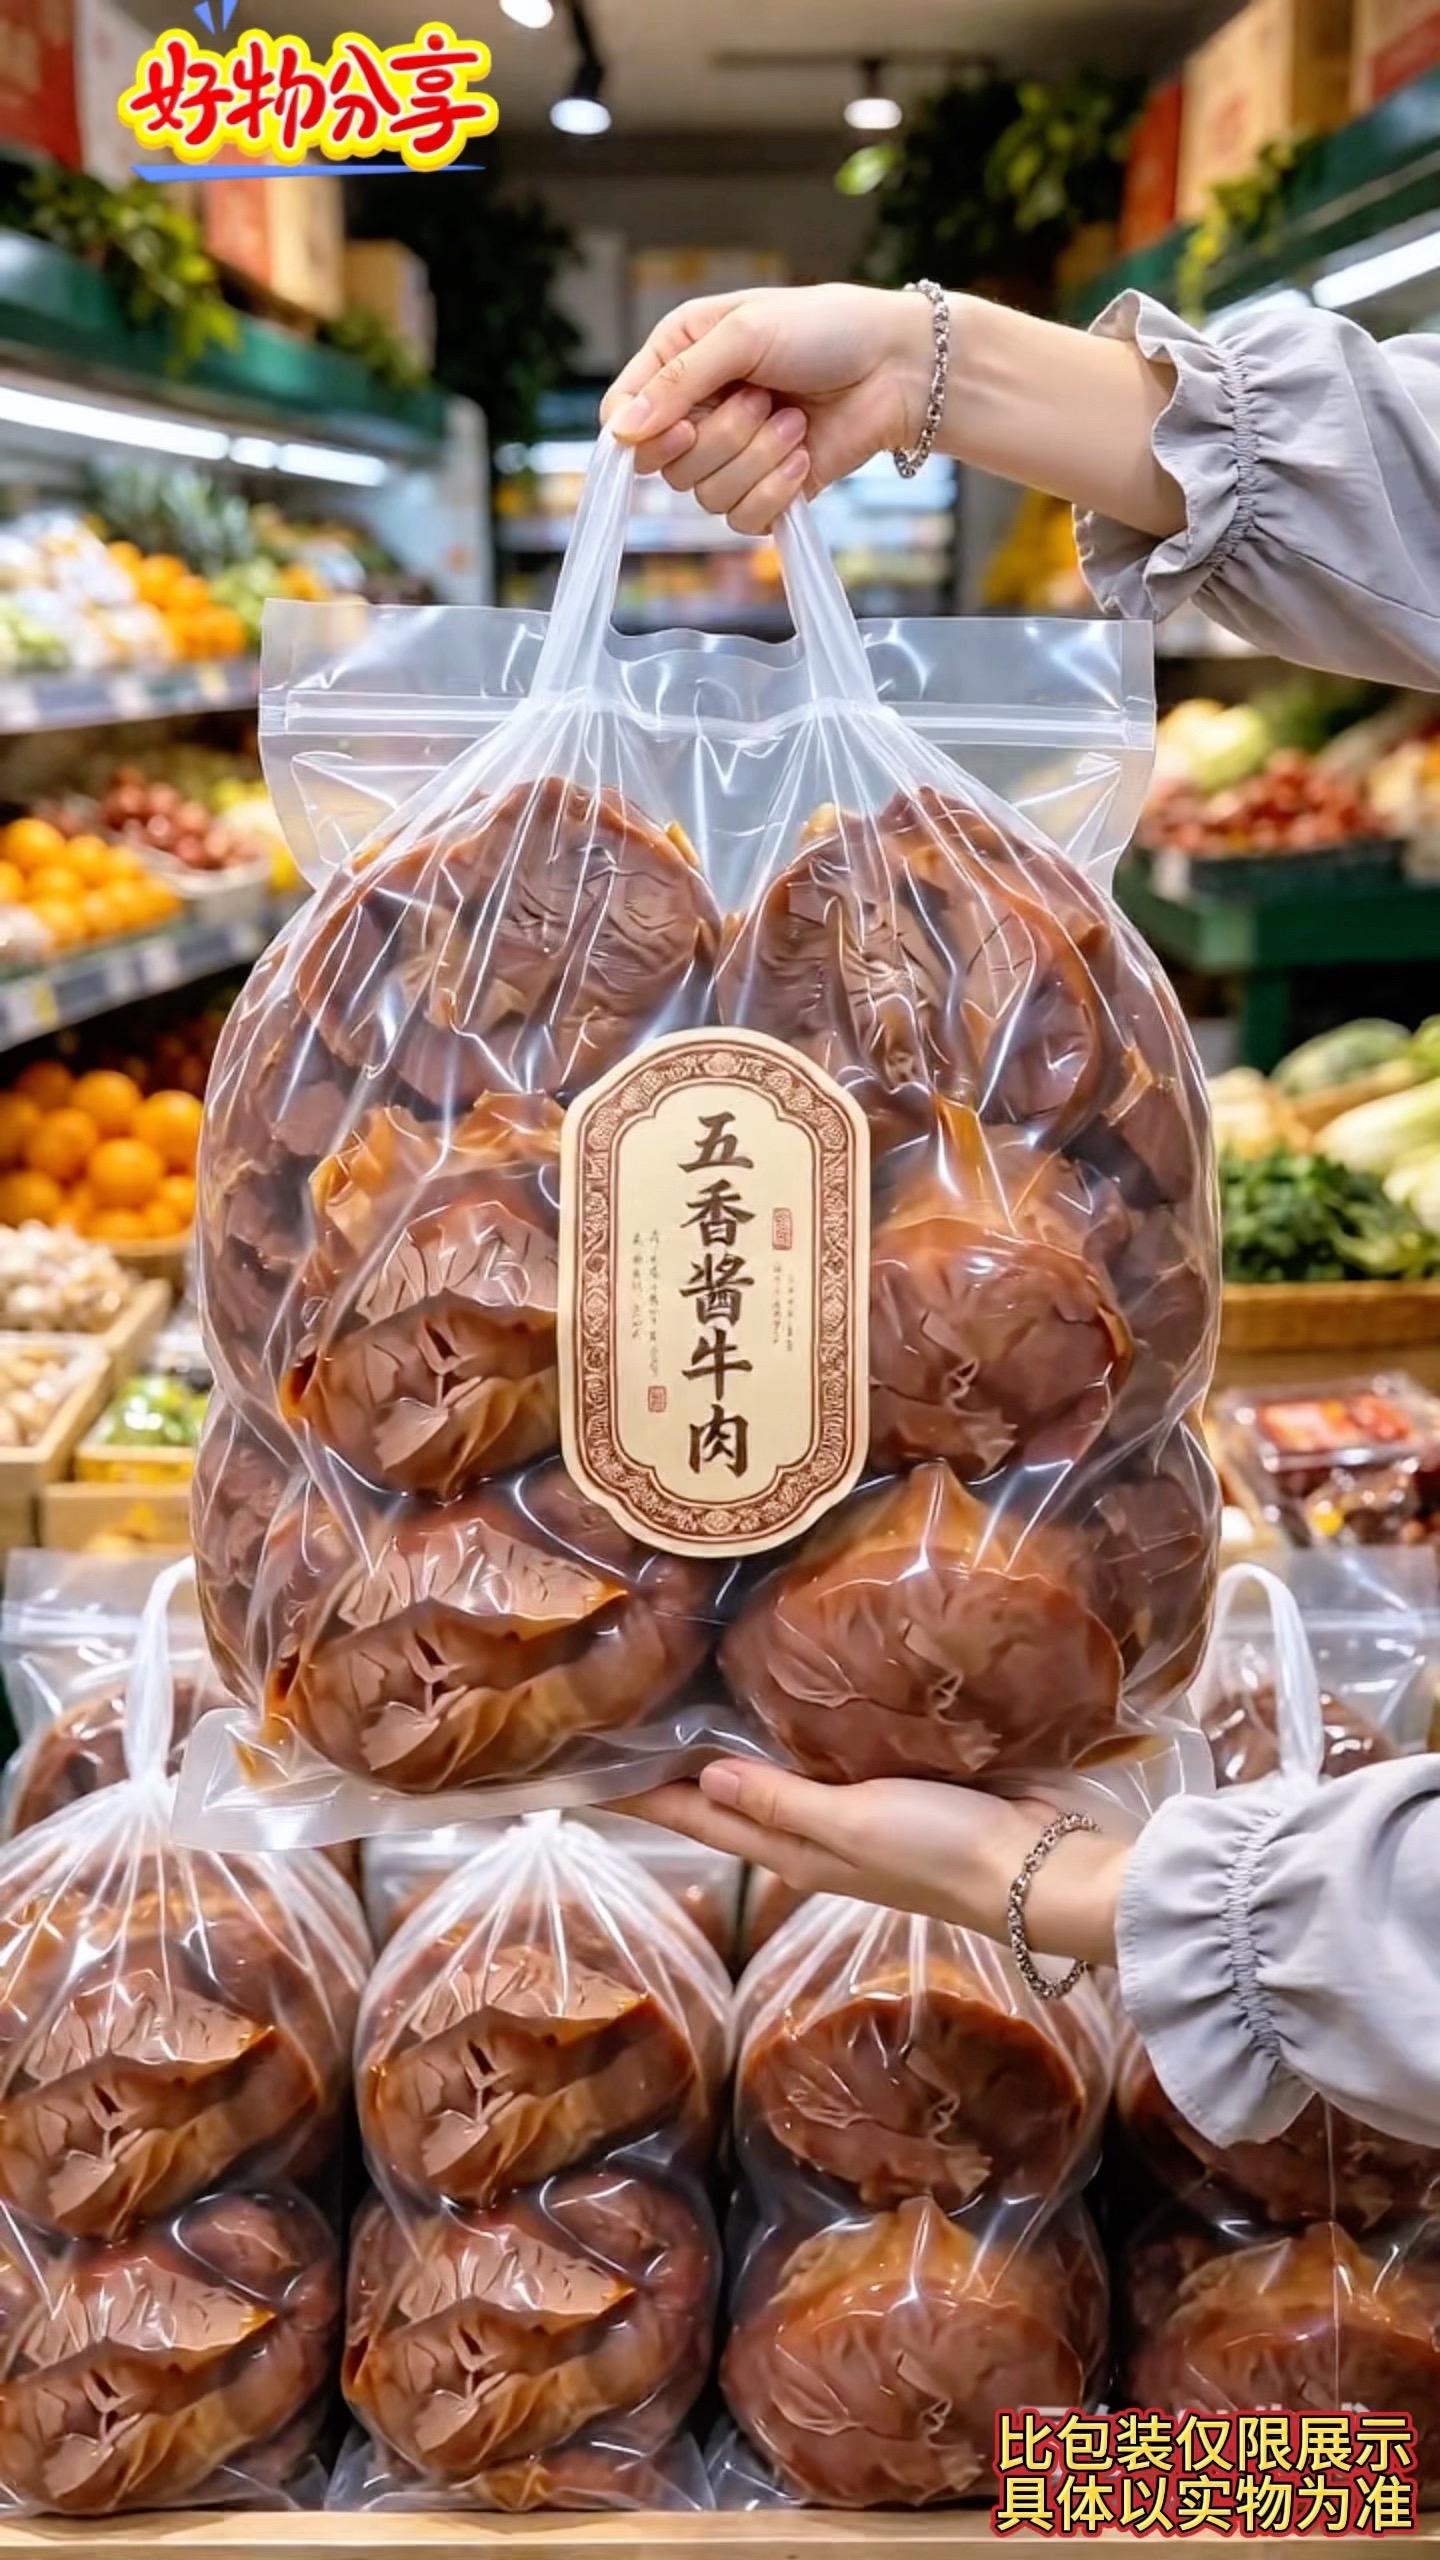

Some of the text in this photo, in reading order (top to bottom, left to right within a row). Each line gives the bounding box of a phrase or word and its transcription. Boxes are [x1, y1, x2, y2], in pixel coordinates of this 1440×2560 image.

[677, 1112, 756, 1479] 五香酱牛肉
